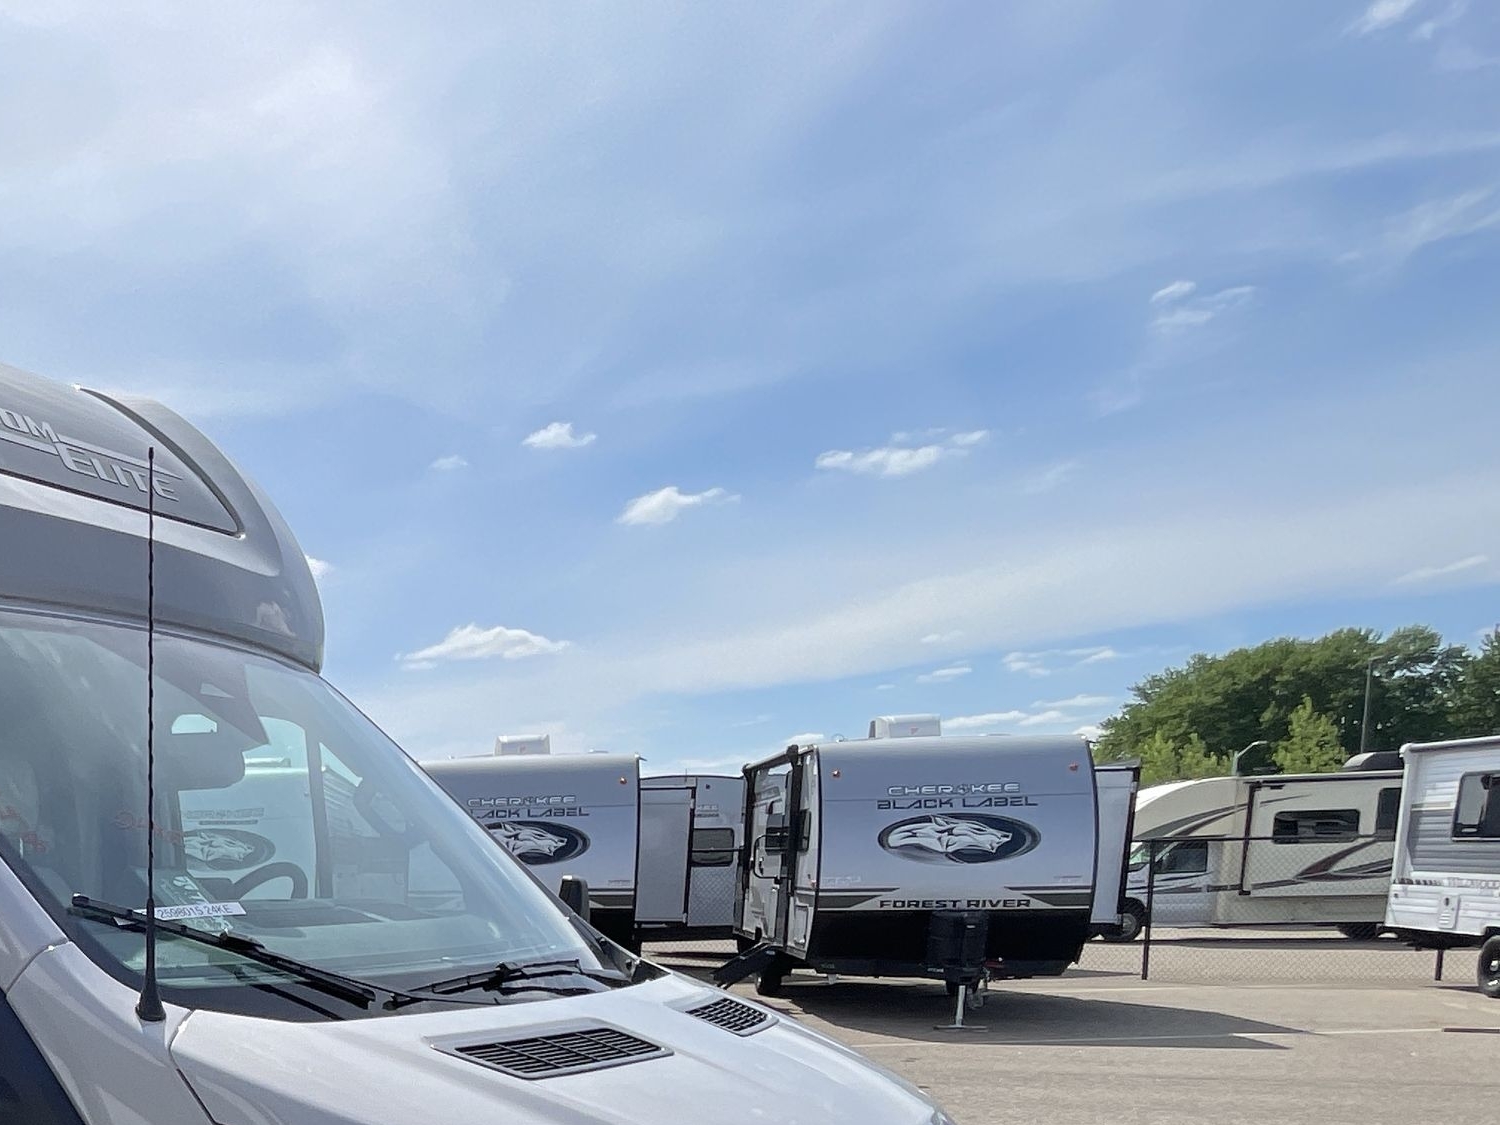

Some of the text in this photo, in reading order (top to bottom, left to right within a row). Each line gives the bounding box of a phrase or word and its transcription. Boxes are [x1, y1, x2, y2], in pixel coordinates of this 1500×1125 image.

[54, 440, 179, 502] ELITE
[887, 781, 1021, 796] CHEROKEE
[877, 796, 1039, 810] BLACK LABEL
[527, 807, 590, 818] LABEL
[879, 898, 1031, 909] FOREST RIVER
